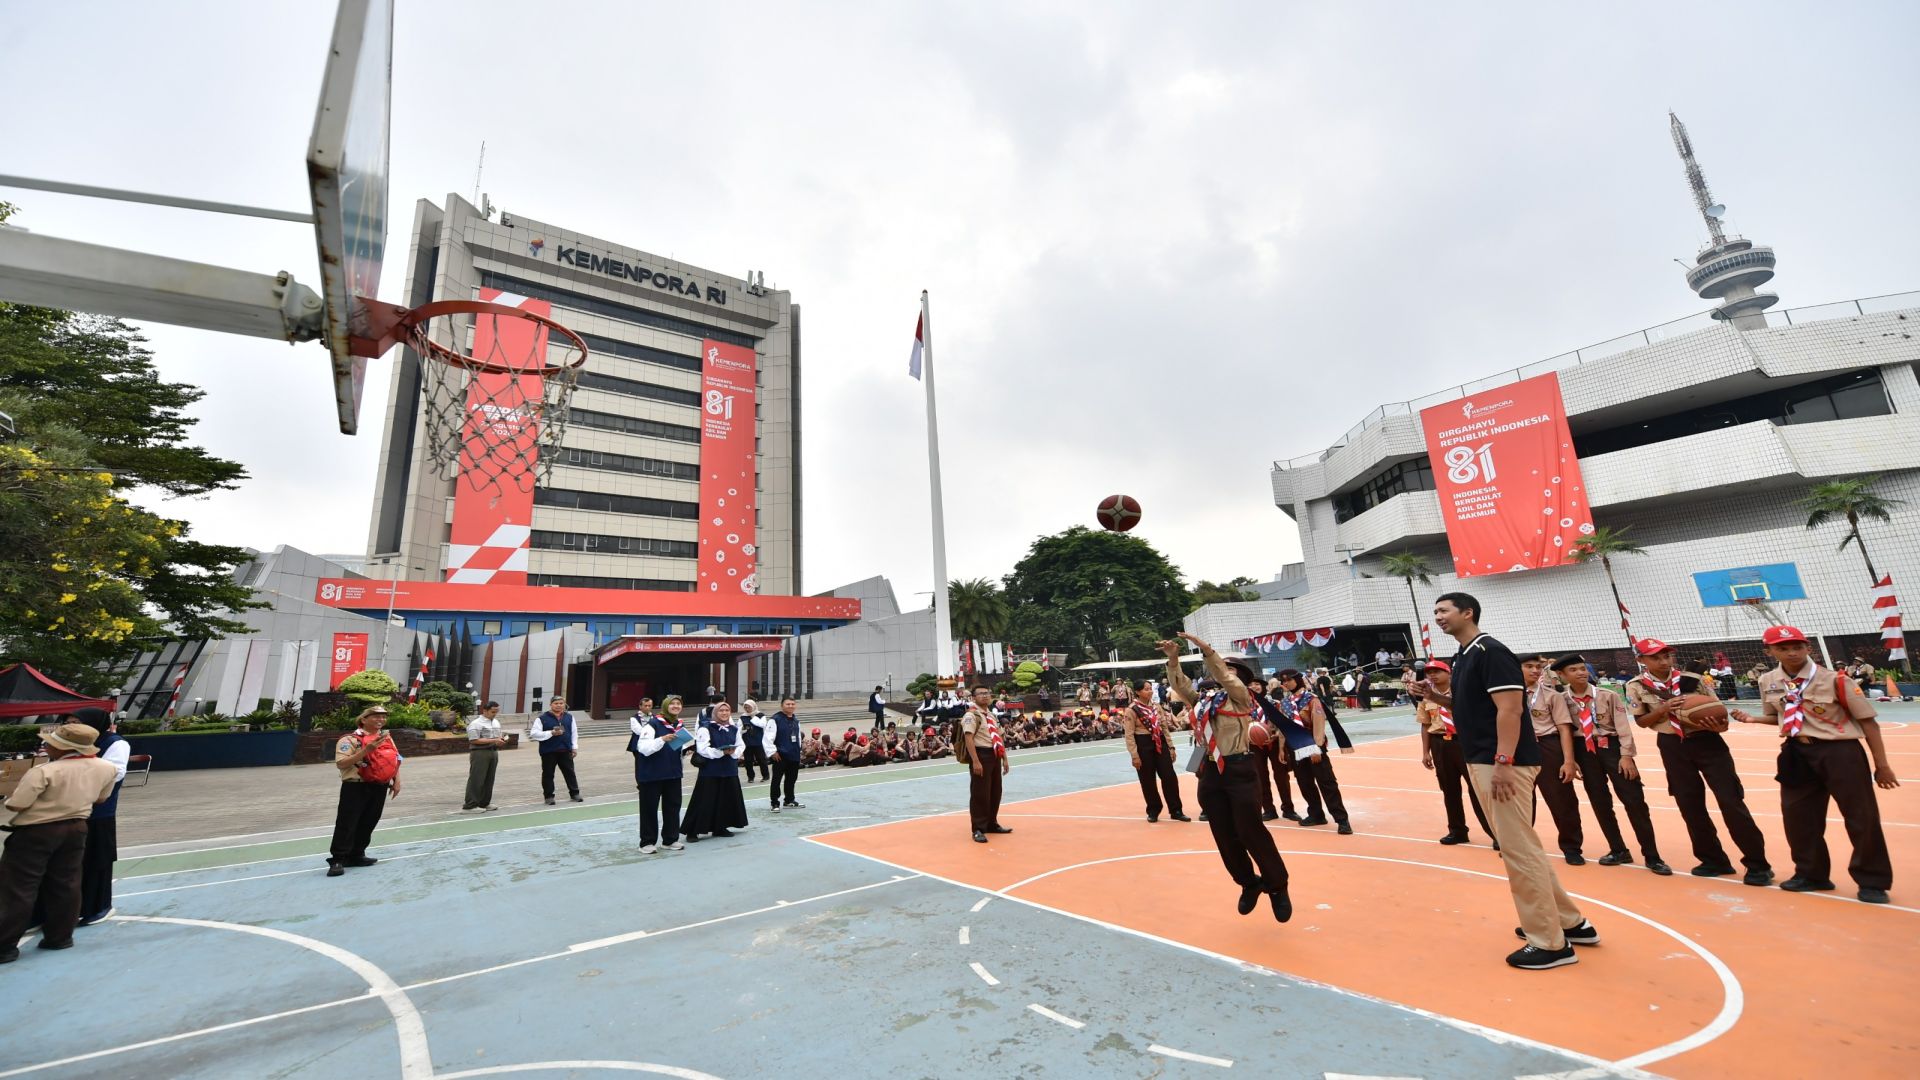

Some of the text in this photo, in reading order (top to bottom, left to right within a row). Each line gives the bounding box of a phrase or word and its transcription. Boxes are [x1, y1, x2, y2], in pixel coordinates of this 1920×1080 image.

[557, 245, 727, 305] KEMENPORA RI
[715, 359, 751, 370] KEMENPORA
[705, 389, 735, 420] 81
[1471, 400, 1514, 414] KEMENPORA
[1438, 418, 1496, 439] DIRGAHAYU
[1440, 414, 1551, 447] REPUBLIK INDONESIA
[1444, 442, 1497, 484] 81
[1453, 485, 1497, 499] INDONESIA
[1454, 492, 1502, 506] BERDAULAT
[1457, 501, 1494, 513] ADIL DAN
[1458, 508, 1496, 520] MAKMUR
[321, 584, 344, 601] 81
[730, 642, 764, 650] INDONESIA
[335, 647, 352, 662] 81
